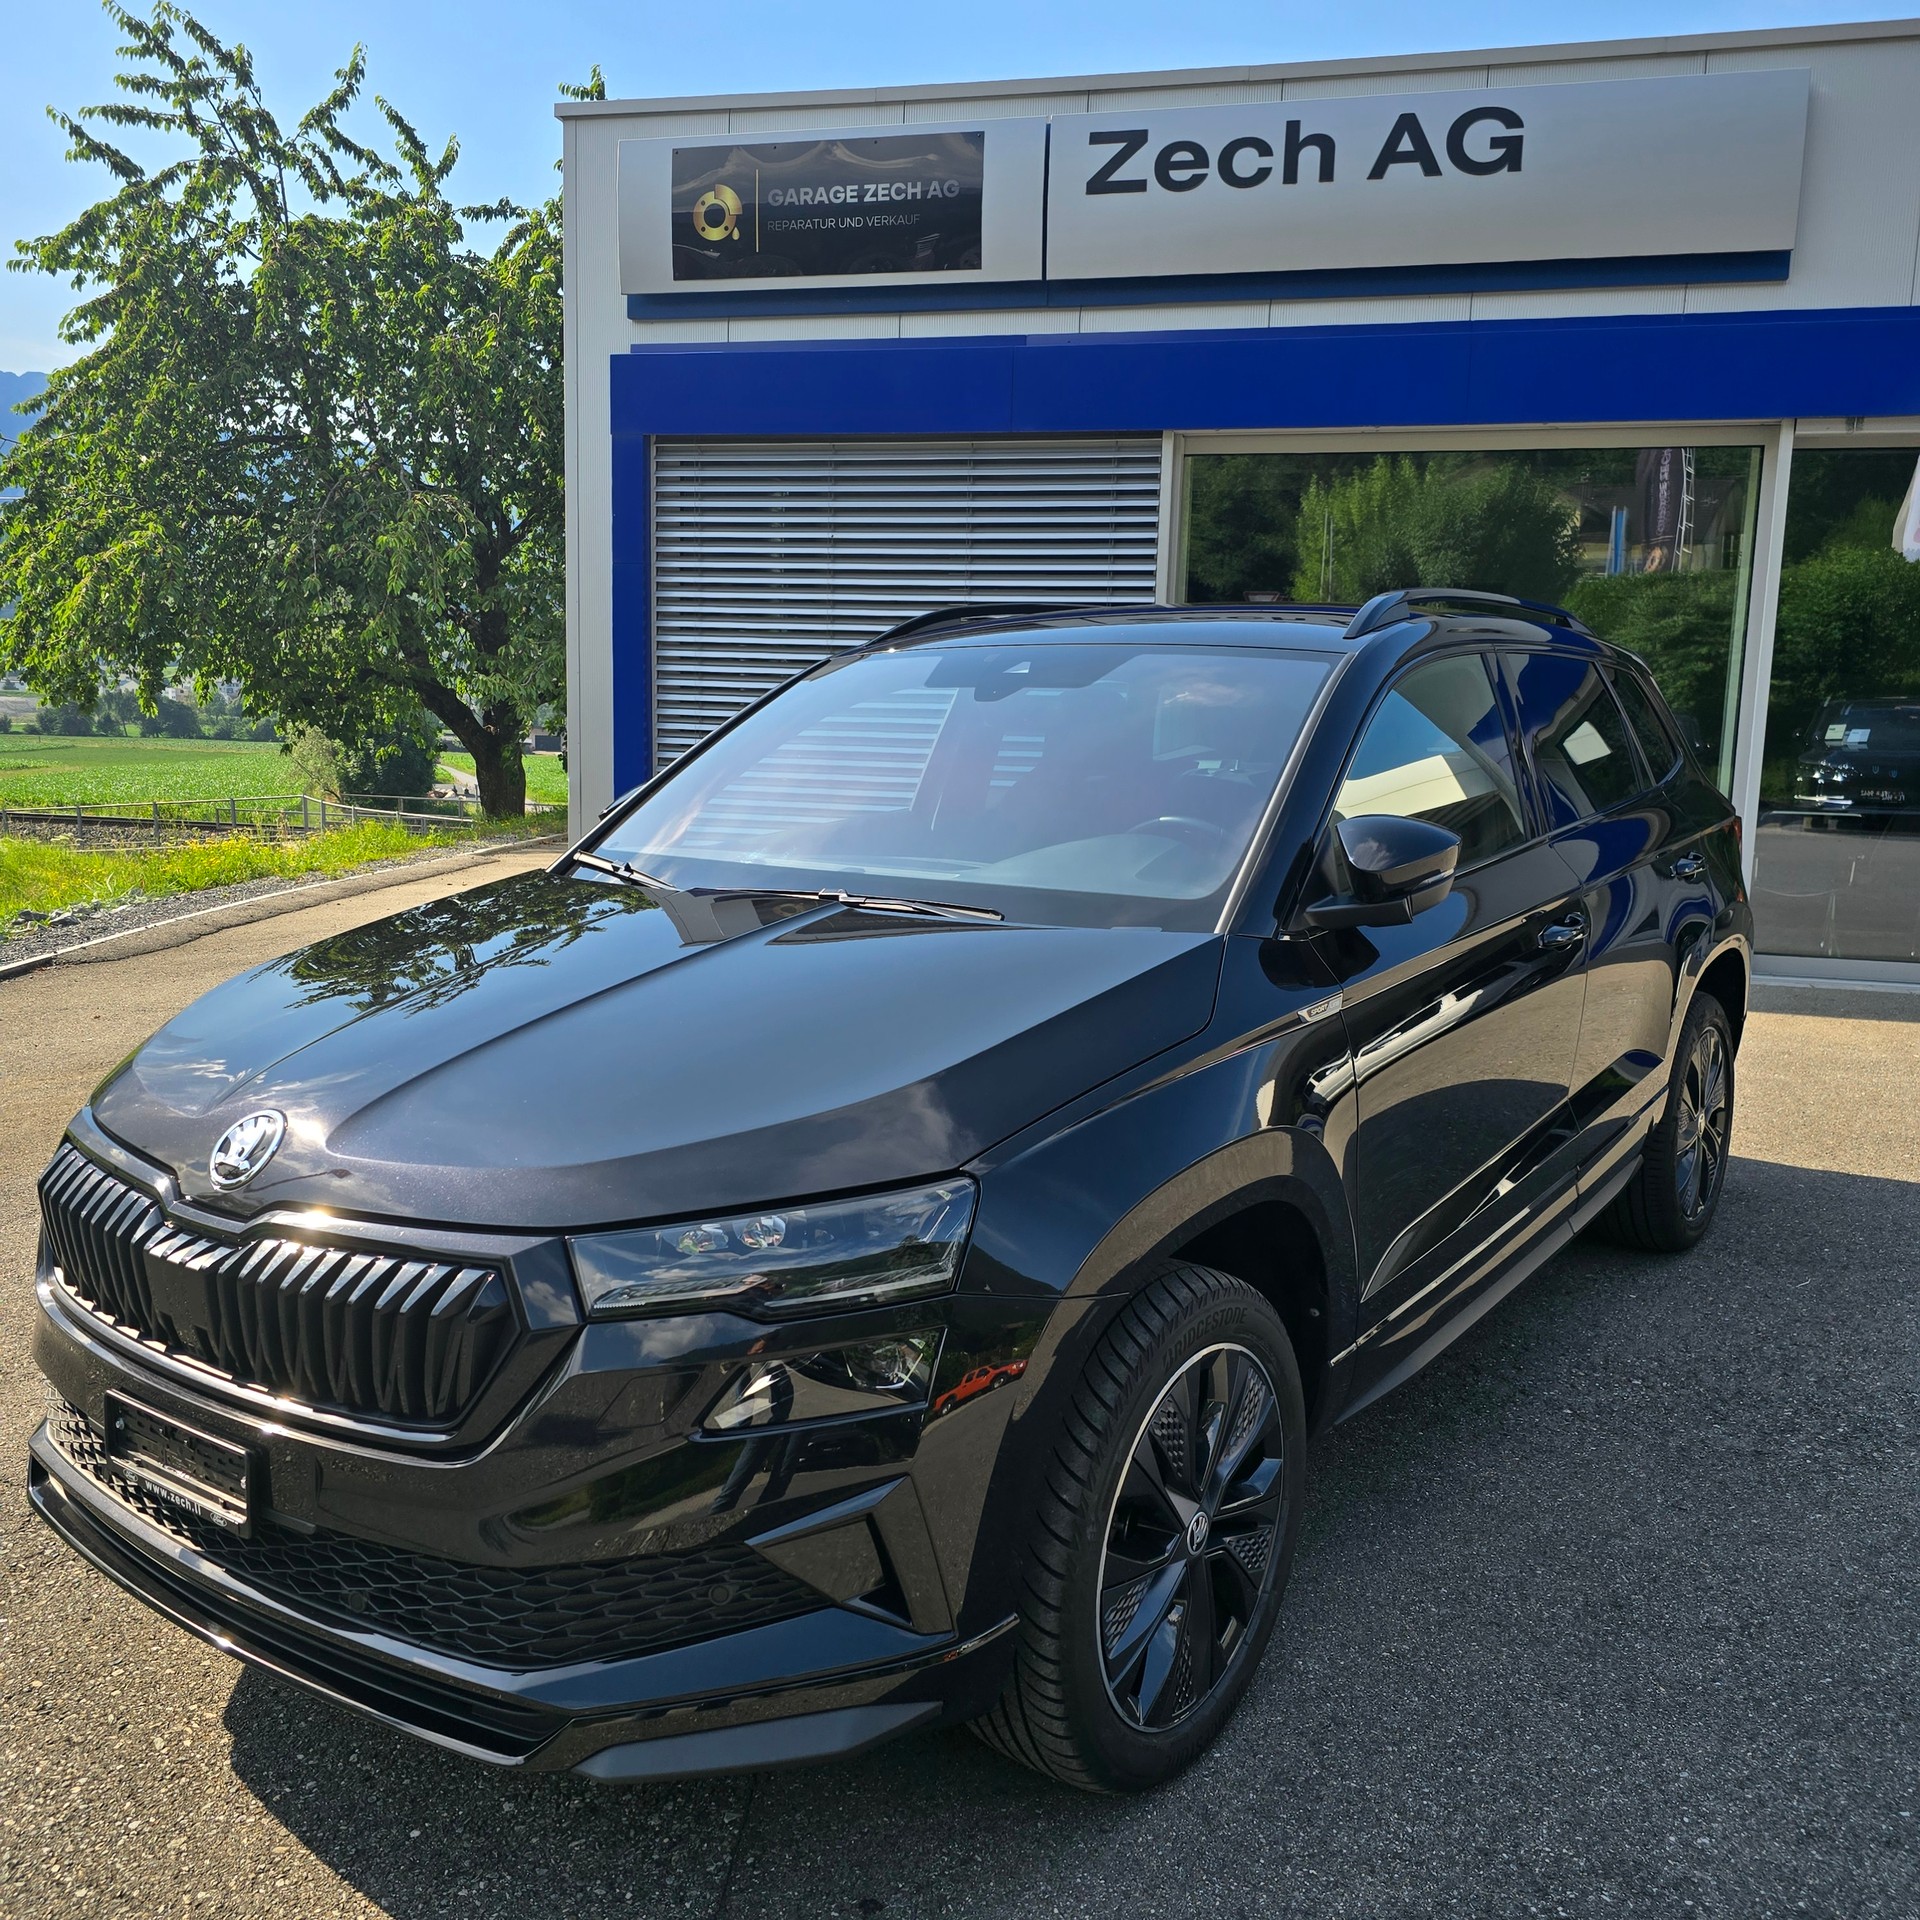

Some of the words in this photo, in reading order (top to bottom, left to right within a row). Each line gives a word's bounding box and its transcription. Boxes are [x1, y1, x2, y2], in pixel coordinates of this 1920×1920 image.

[1085, 119, 1336, 195] Zech
[1366, 105, 1525, 180] AG
[768, 184, 858, 207] GARAGE
[863, 181, 921, 203] ZECH
[927, 178, 960, 199] AG
[767, 217, 836, 231] REPARATUR
[838, 216, 863, 228] UND
[866, 213, 921, 227] VERKAUF
[1162, 1307, 1248, 1369] BRIDGESTONE
